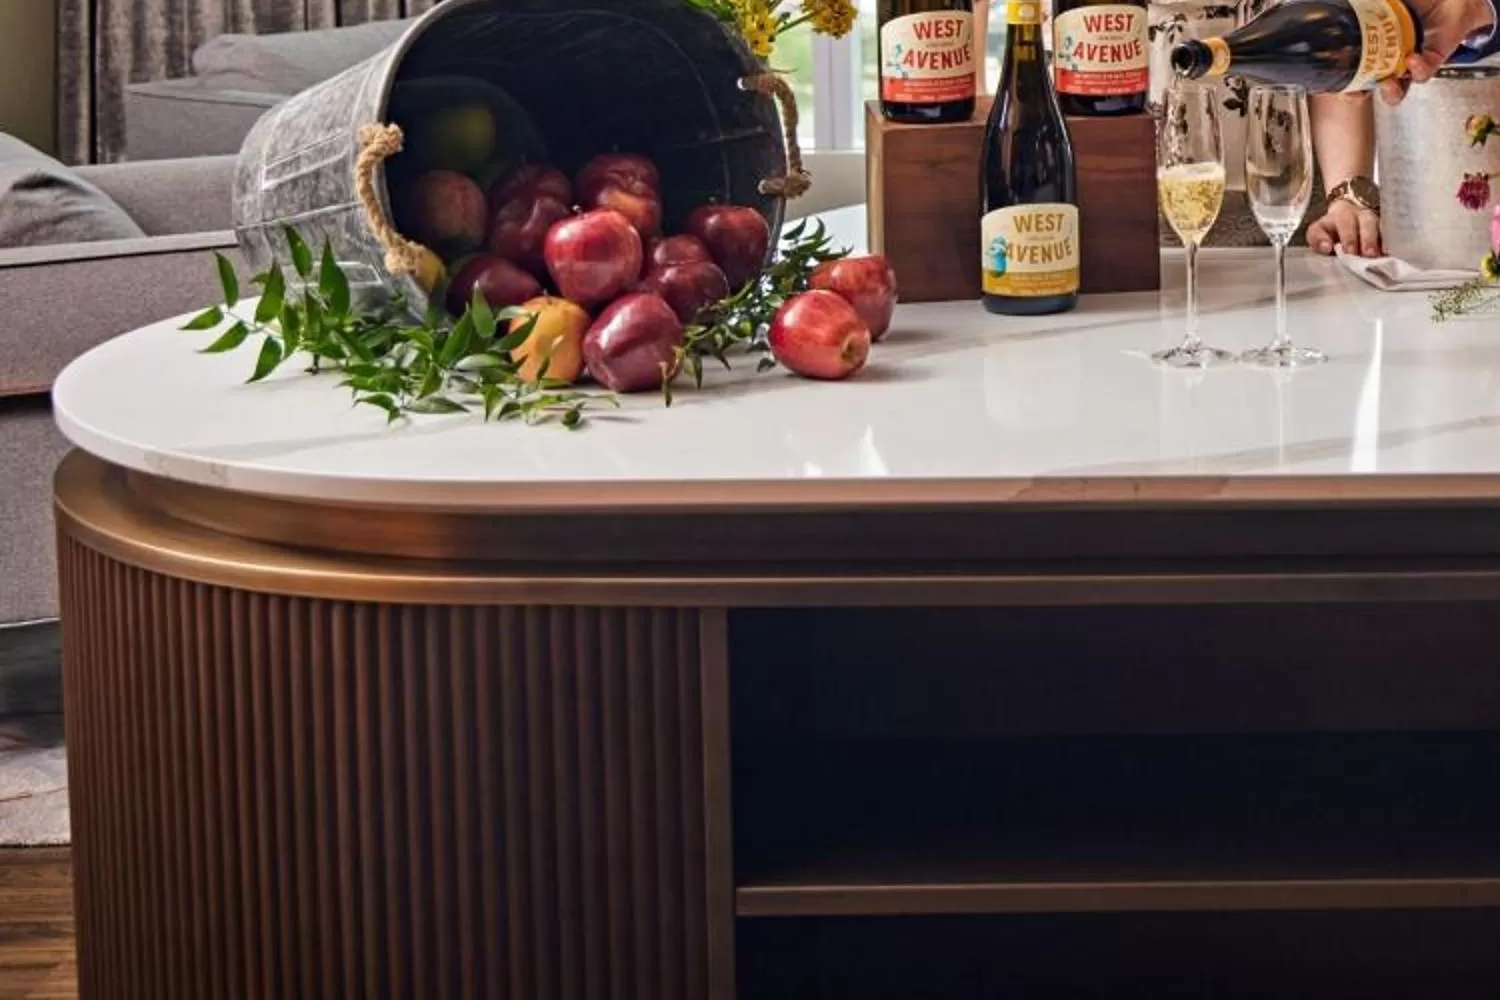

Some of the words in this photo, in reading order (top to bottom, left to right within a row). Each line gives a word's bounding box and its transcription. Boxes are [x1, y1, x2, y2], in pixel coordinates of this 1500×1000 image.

[912, 19, 964, 40] WEST
[1083, 13, 1135, 32] WEST
[1072, 39, 1142, 63] AVENUE
[1362, 23, 1380, 75] WEST
[1376, 6, 1397, 71] VENUE
[903, 43, 971, 70] AVENUE
[1013, 213, 1065, 233] WEST
[1005, 237, 1073, 265] AVENUE
